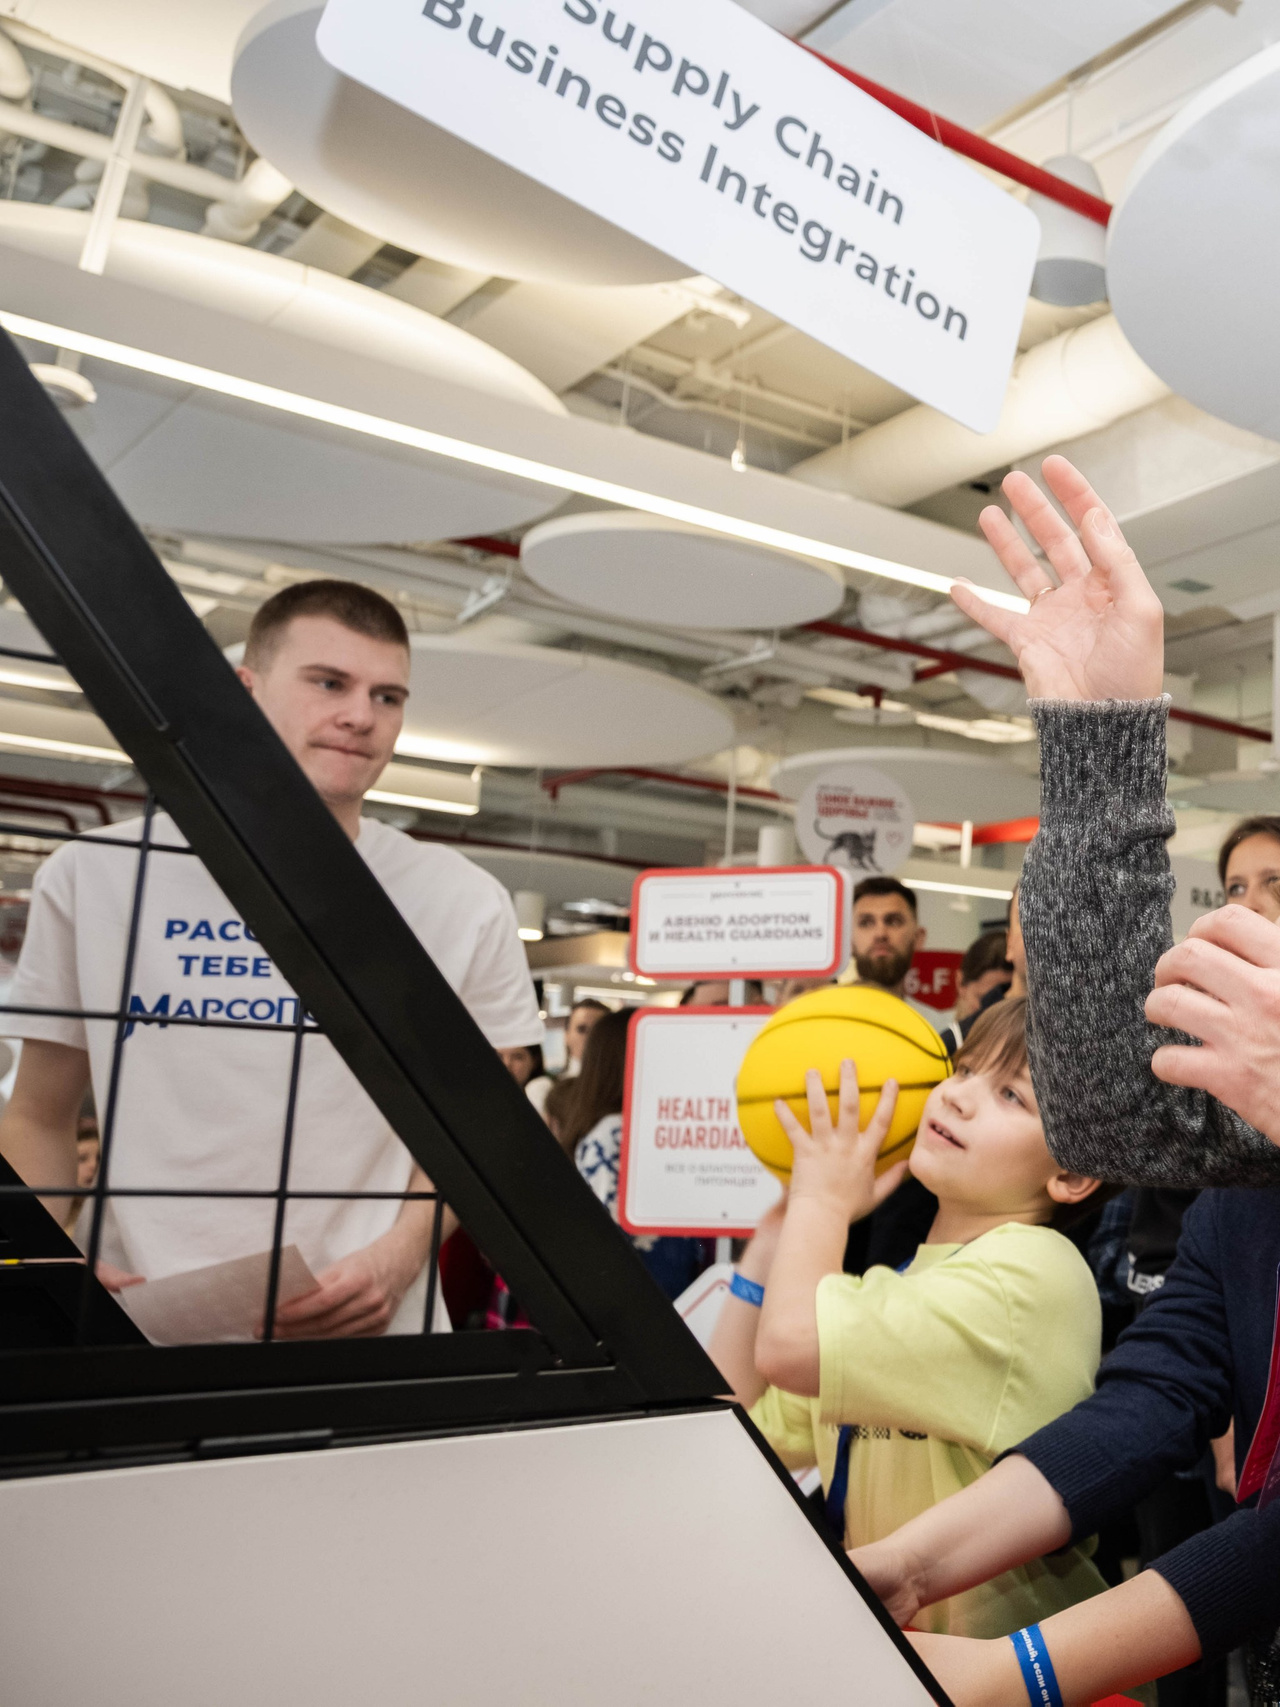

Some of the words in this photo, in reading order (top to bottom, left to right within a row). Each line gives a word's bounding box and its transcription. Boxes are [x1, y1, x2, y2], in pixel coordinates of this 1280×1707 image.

[563, 0, 761, 131] Supply
[774, 114, 906, 226] Chain
[421, 0, 686, 164] Business
[699, 144, 970, 342] Integration
[727, 913, 811, 925] ADOPTION
[664, 929, 725, 942] HEALTH
[730, 927, 823, 941] GUARDIANS
[177, 954, 272, 977] ТЕБЕ
[657, 1098, 730, 1121] HEALTH
[1033, 1662, 1046, 1688] если
